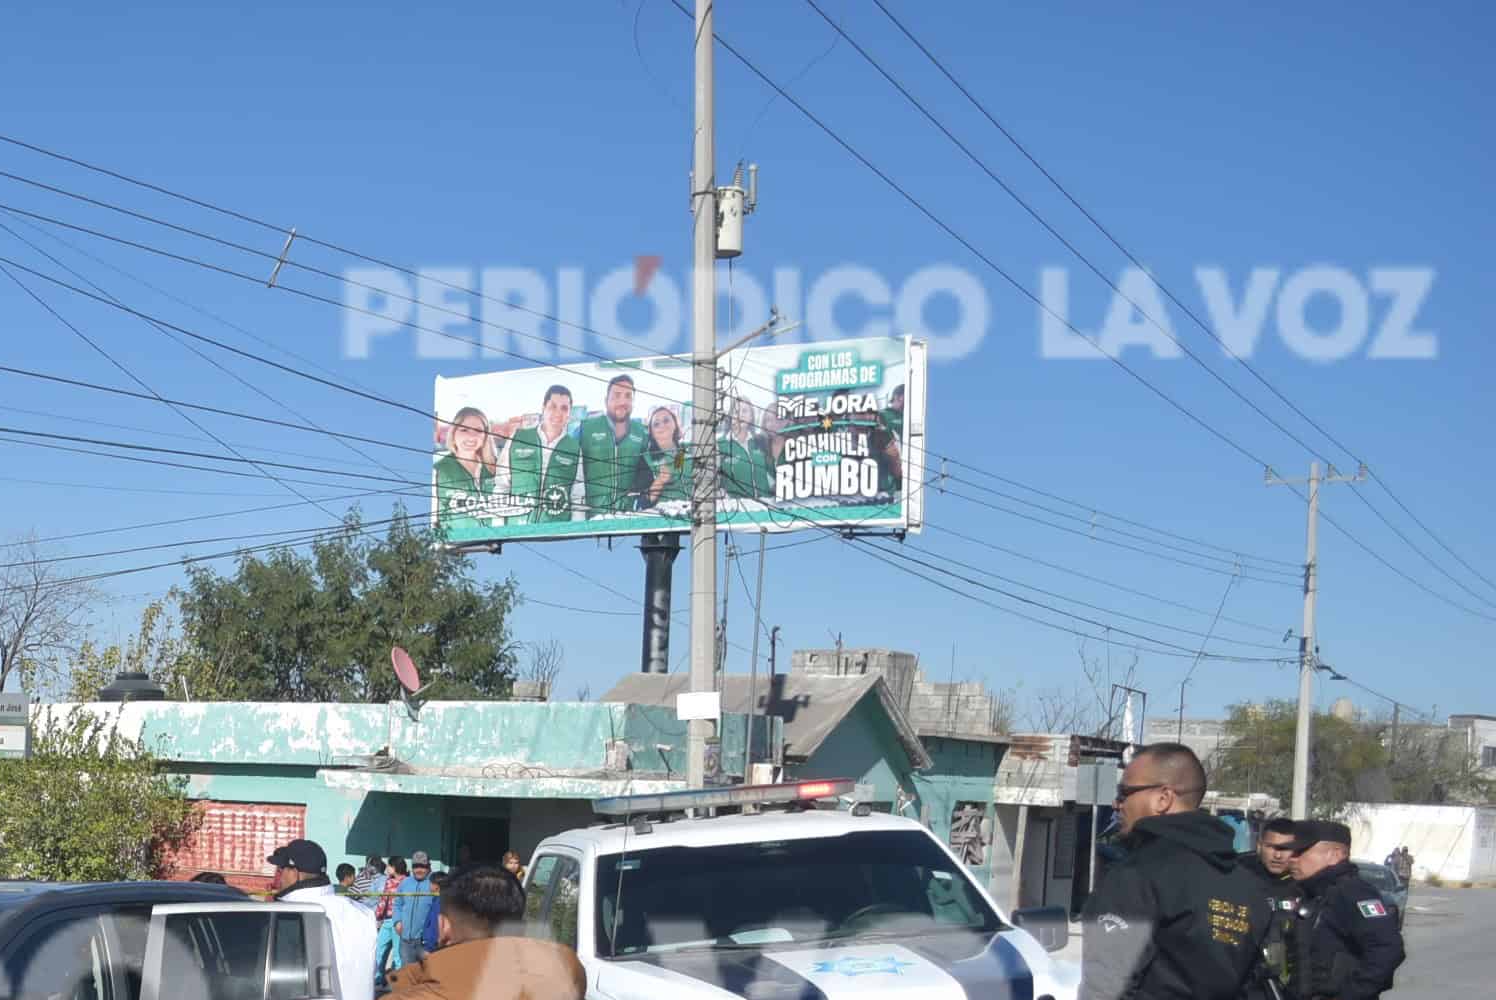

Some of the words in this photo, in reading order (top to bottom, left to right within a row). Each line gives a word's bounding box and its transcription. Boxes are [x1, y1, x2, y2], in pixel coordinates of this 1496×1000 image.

[808, 354, 828, 370] CON
[832, 351, 853, 368] LOS
[782, 367, 858, 390] PROGRAMAS
[860, 365, 877, 384] DE
[777, 393, 878, 419] MEJORA
[784, 432, 870, 461] COAHUILA
[815, 454, 837, 463] CON
[775, 458, 879, 502] RUMBO
[6, 703, 22, 713] José
